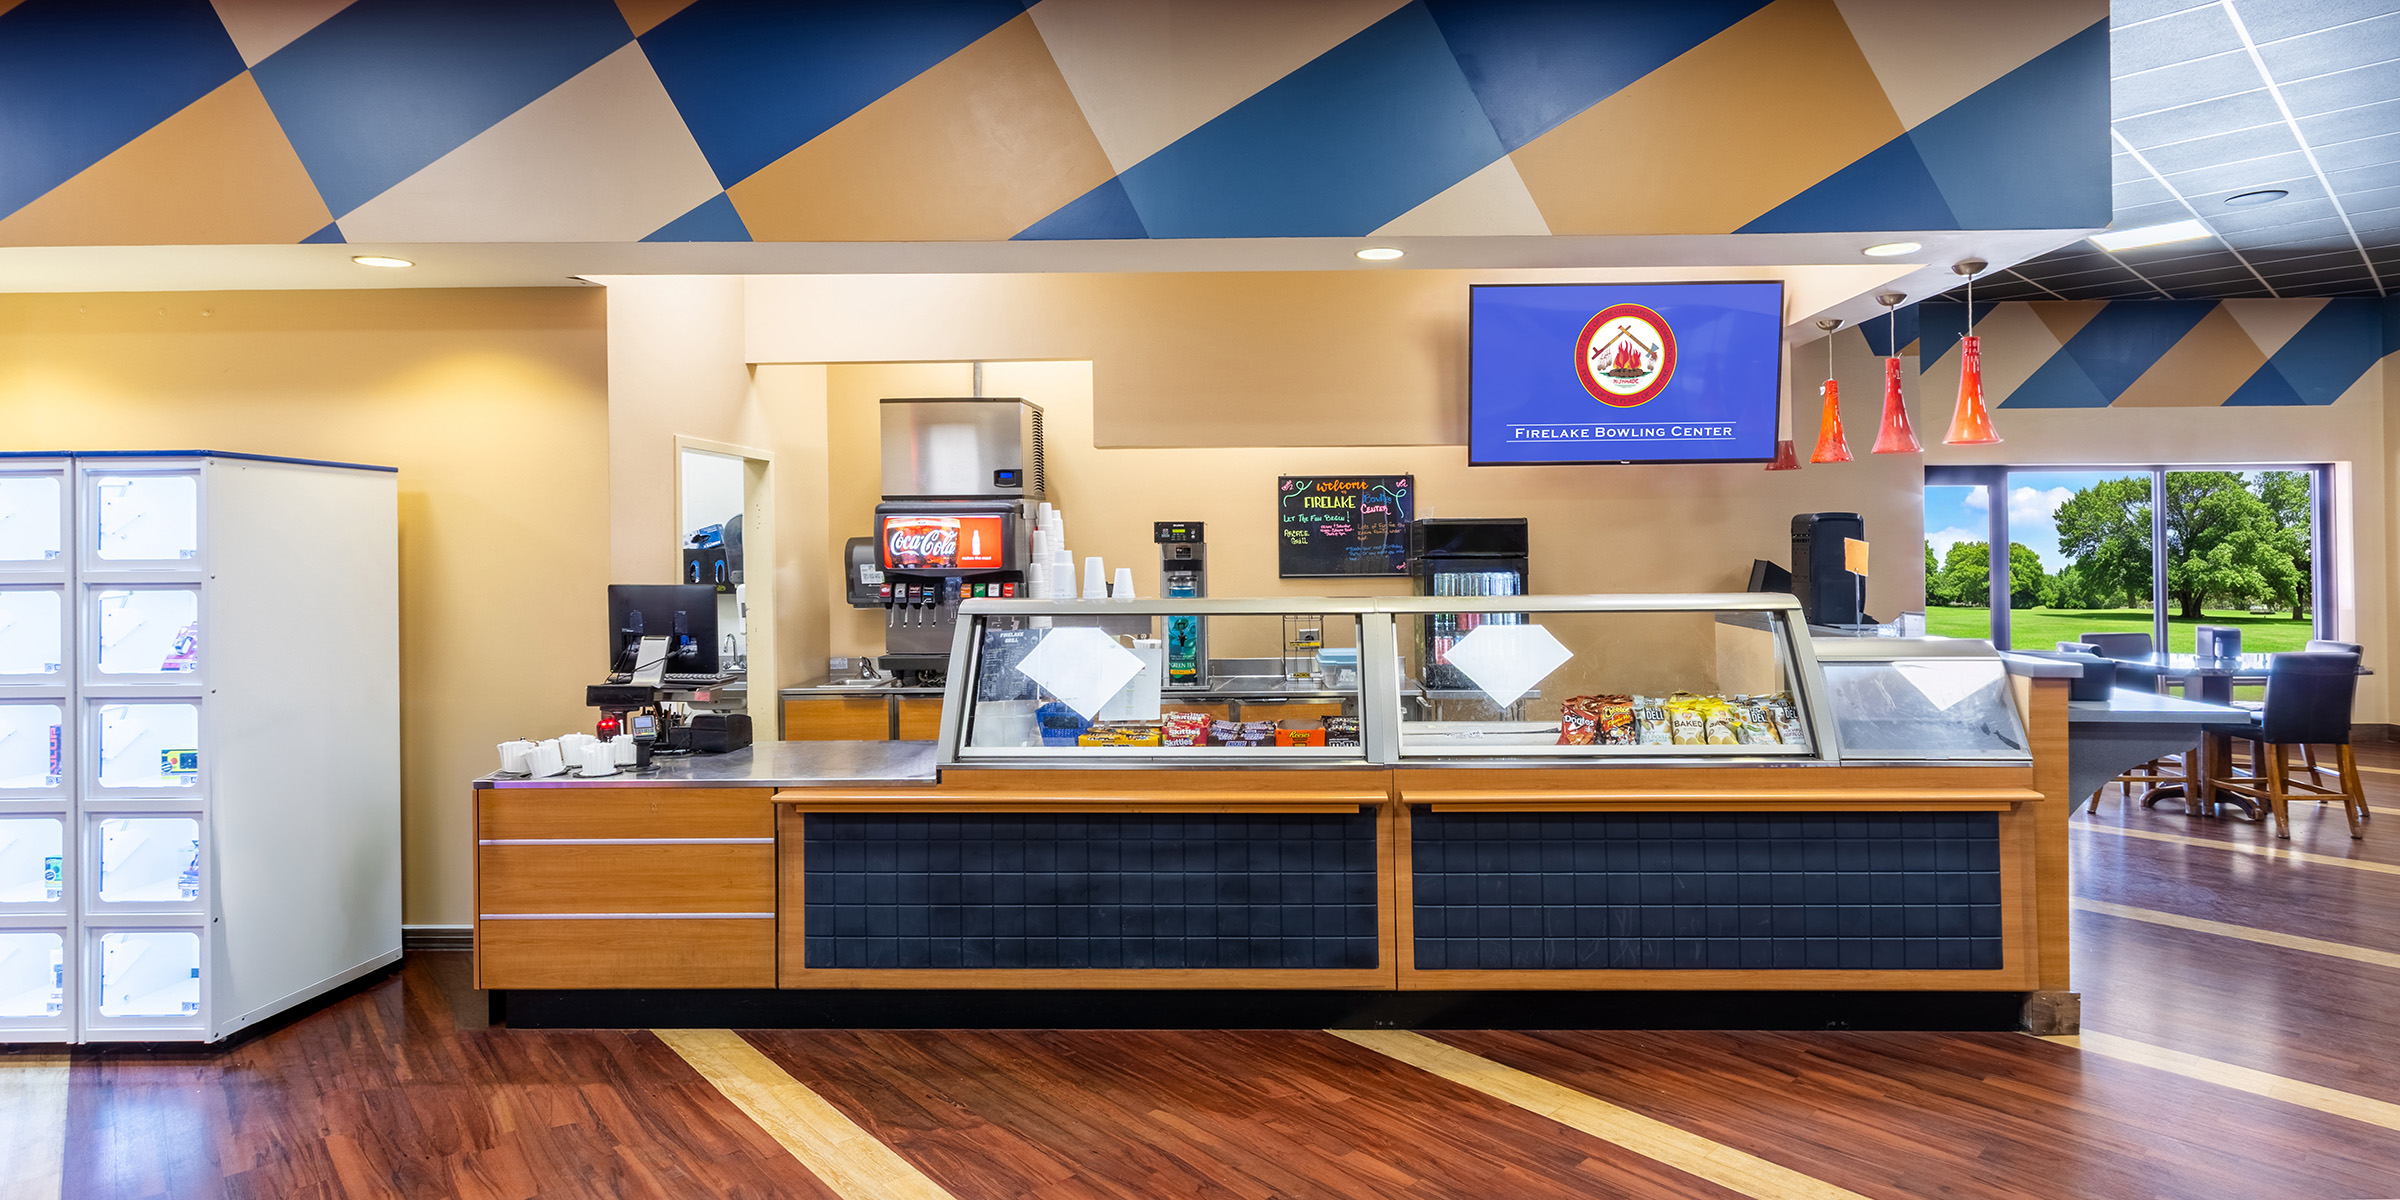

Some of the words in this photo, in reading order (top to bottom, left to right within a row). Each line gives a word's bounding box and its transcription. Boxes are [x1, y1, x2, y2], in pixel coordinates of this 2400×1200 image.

[1515, 428, 1589, 439] FIRELAKE
[1595, 427, 1666, 438] BOWLING
[1671, 426, 1733, 437] CENTER
[1304, 495, 1356, 509] FIRELAKE
